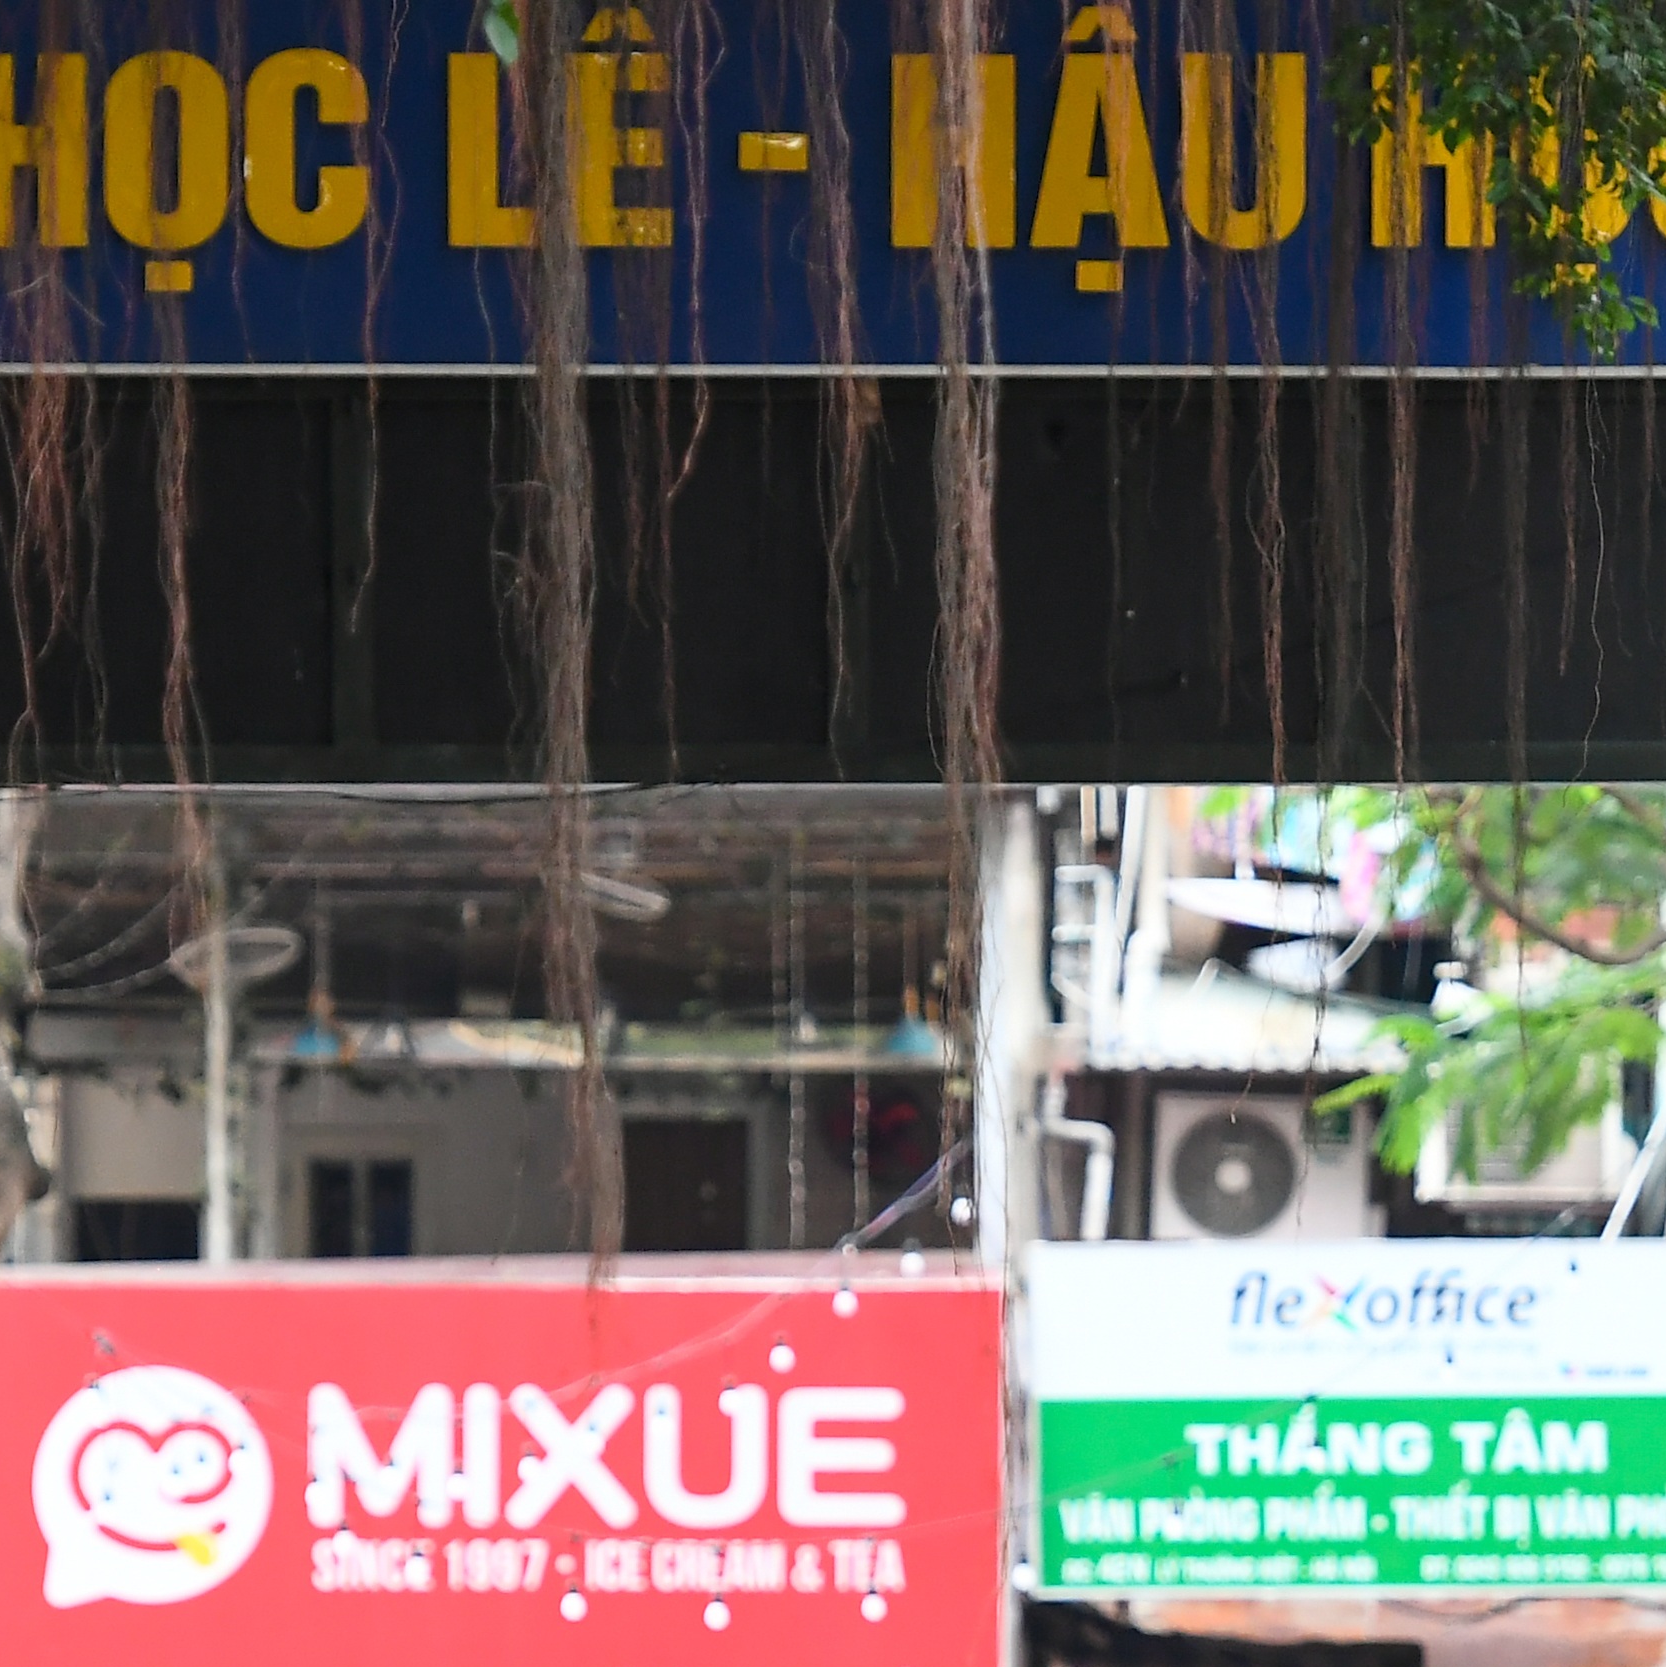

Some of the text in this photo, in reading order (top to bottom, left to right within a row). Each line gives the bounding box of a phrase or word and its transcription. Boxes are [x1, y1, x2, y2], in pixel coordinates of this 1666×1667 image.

[1231, 1268, 1536, 1333] flexoffice
[307, 1383, 907, 1529] MIXUE
[444, 1538, 550, 1592] 1997
[584, 1538, 648, 1592] ICE
[790, 1543, 824, 1592] &
[828, 1538, 906, 1592] TEA
